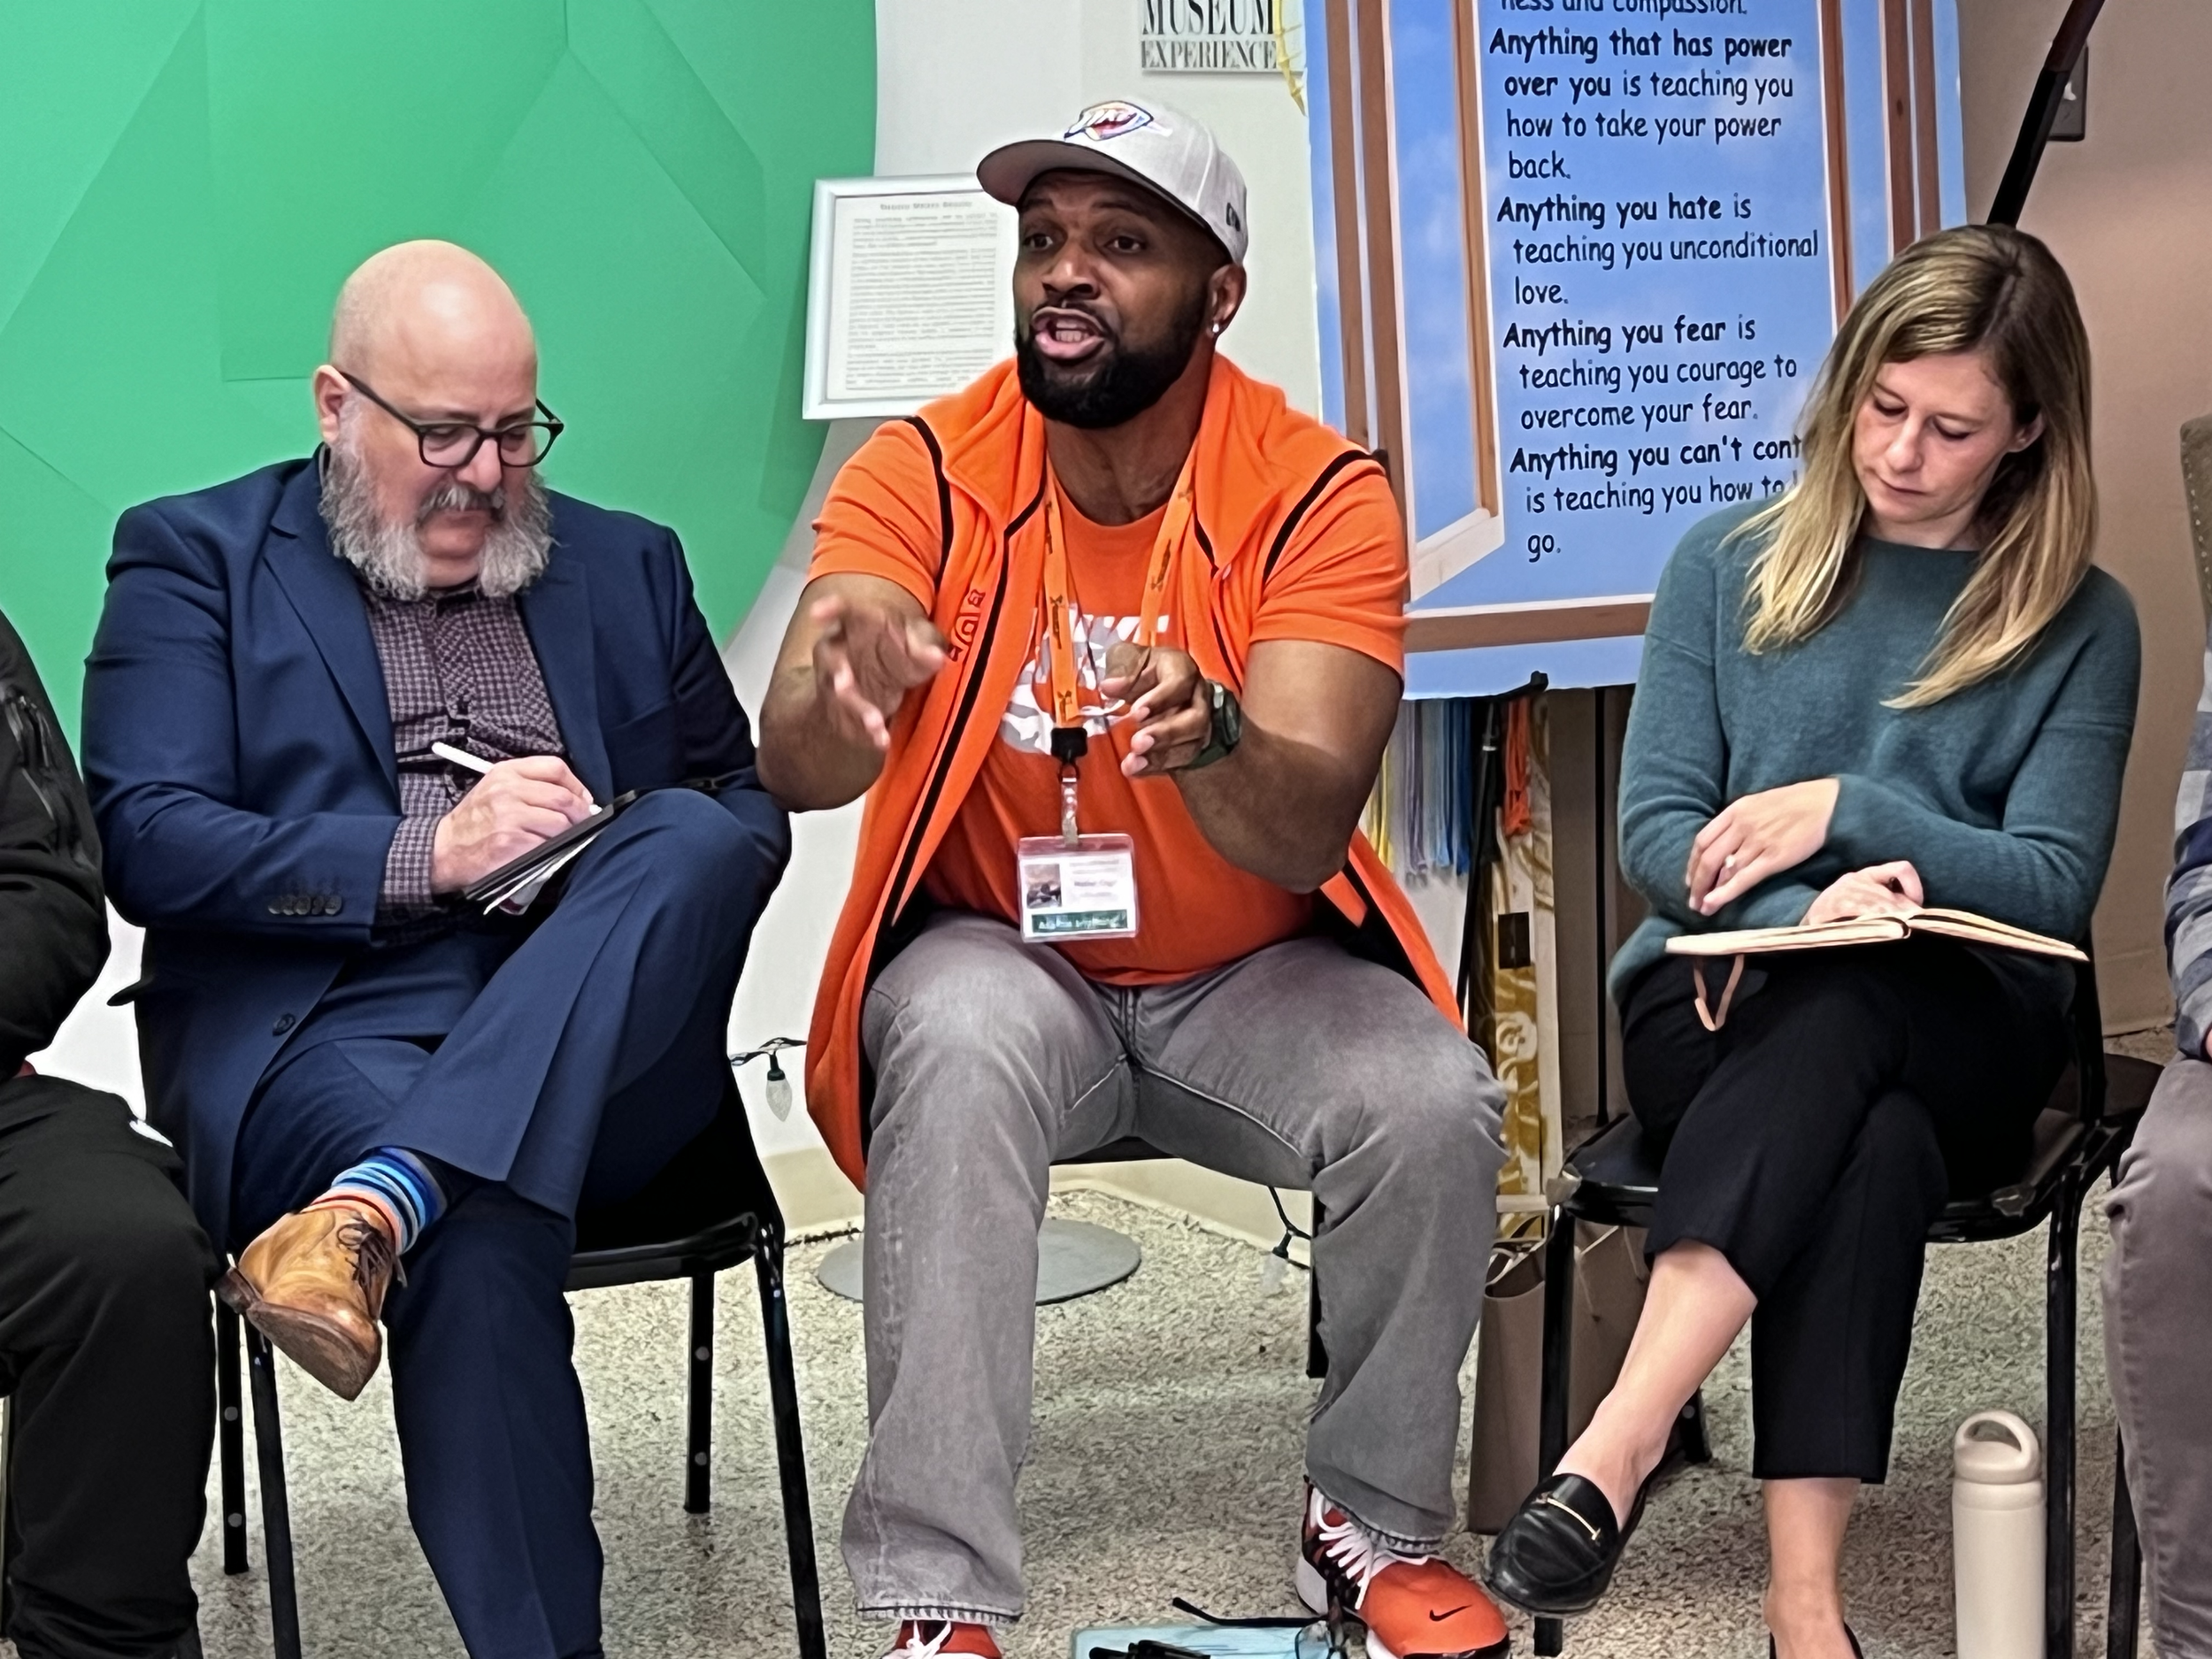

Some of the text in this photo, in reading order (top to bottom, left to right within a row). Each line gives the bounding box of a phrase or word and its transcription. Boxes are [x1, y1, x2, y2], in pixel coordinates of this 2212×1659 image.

[1142, 0, 1274, 35] MUSEUM
[1141, 41, 1278, 69] EXPERIENCE
[1489, 25, 1793, 65] Anything that has power
[1504, 68, 1793, 106] over you is teaching you
[1506, 108, 1782, 146] how to take your power
[1509, 150, 1571, 180] back.
[1496, 191, 1752, 232] Anything you hate is
[1512, 229, 1818, 271] teaching you unconditional
[1515, 275, 1569, 305] love.
[1502, 313, 1755, 357] Anything you fear is
[1518, 354, 1797, 394] teaching you courage to
[1521, 392, 1759, 433] overcome your fear.
[1509, 434, 1801, 480] Anything you can't cont
[1526, 487, 1545, 514] is
[1553, 480, 1655, 515] teaching
[1661, 485, 1701, 514] you
[1709, 475, 1753, 503] how
[1761, 475, 1784, 496] to
[1527, 534, 1561, 563] go.
